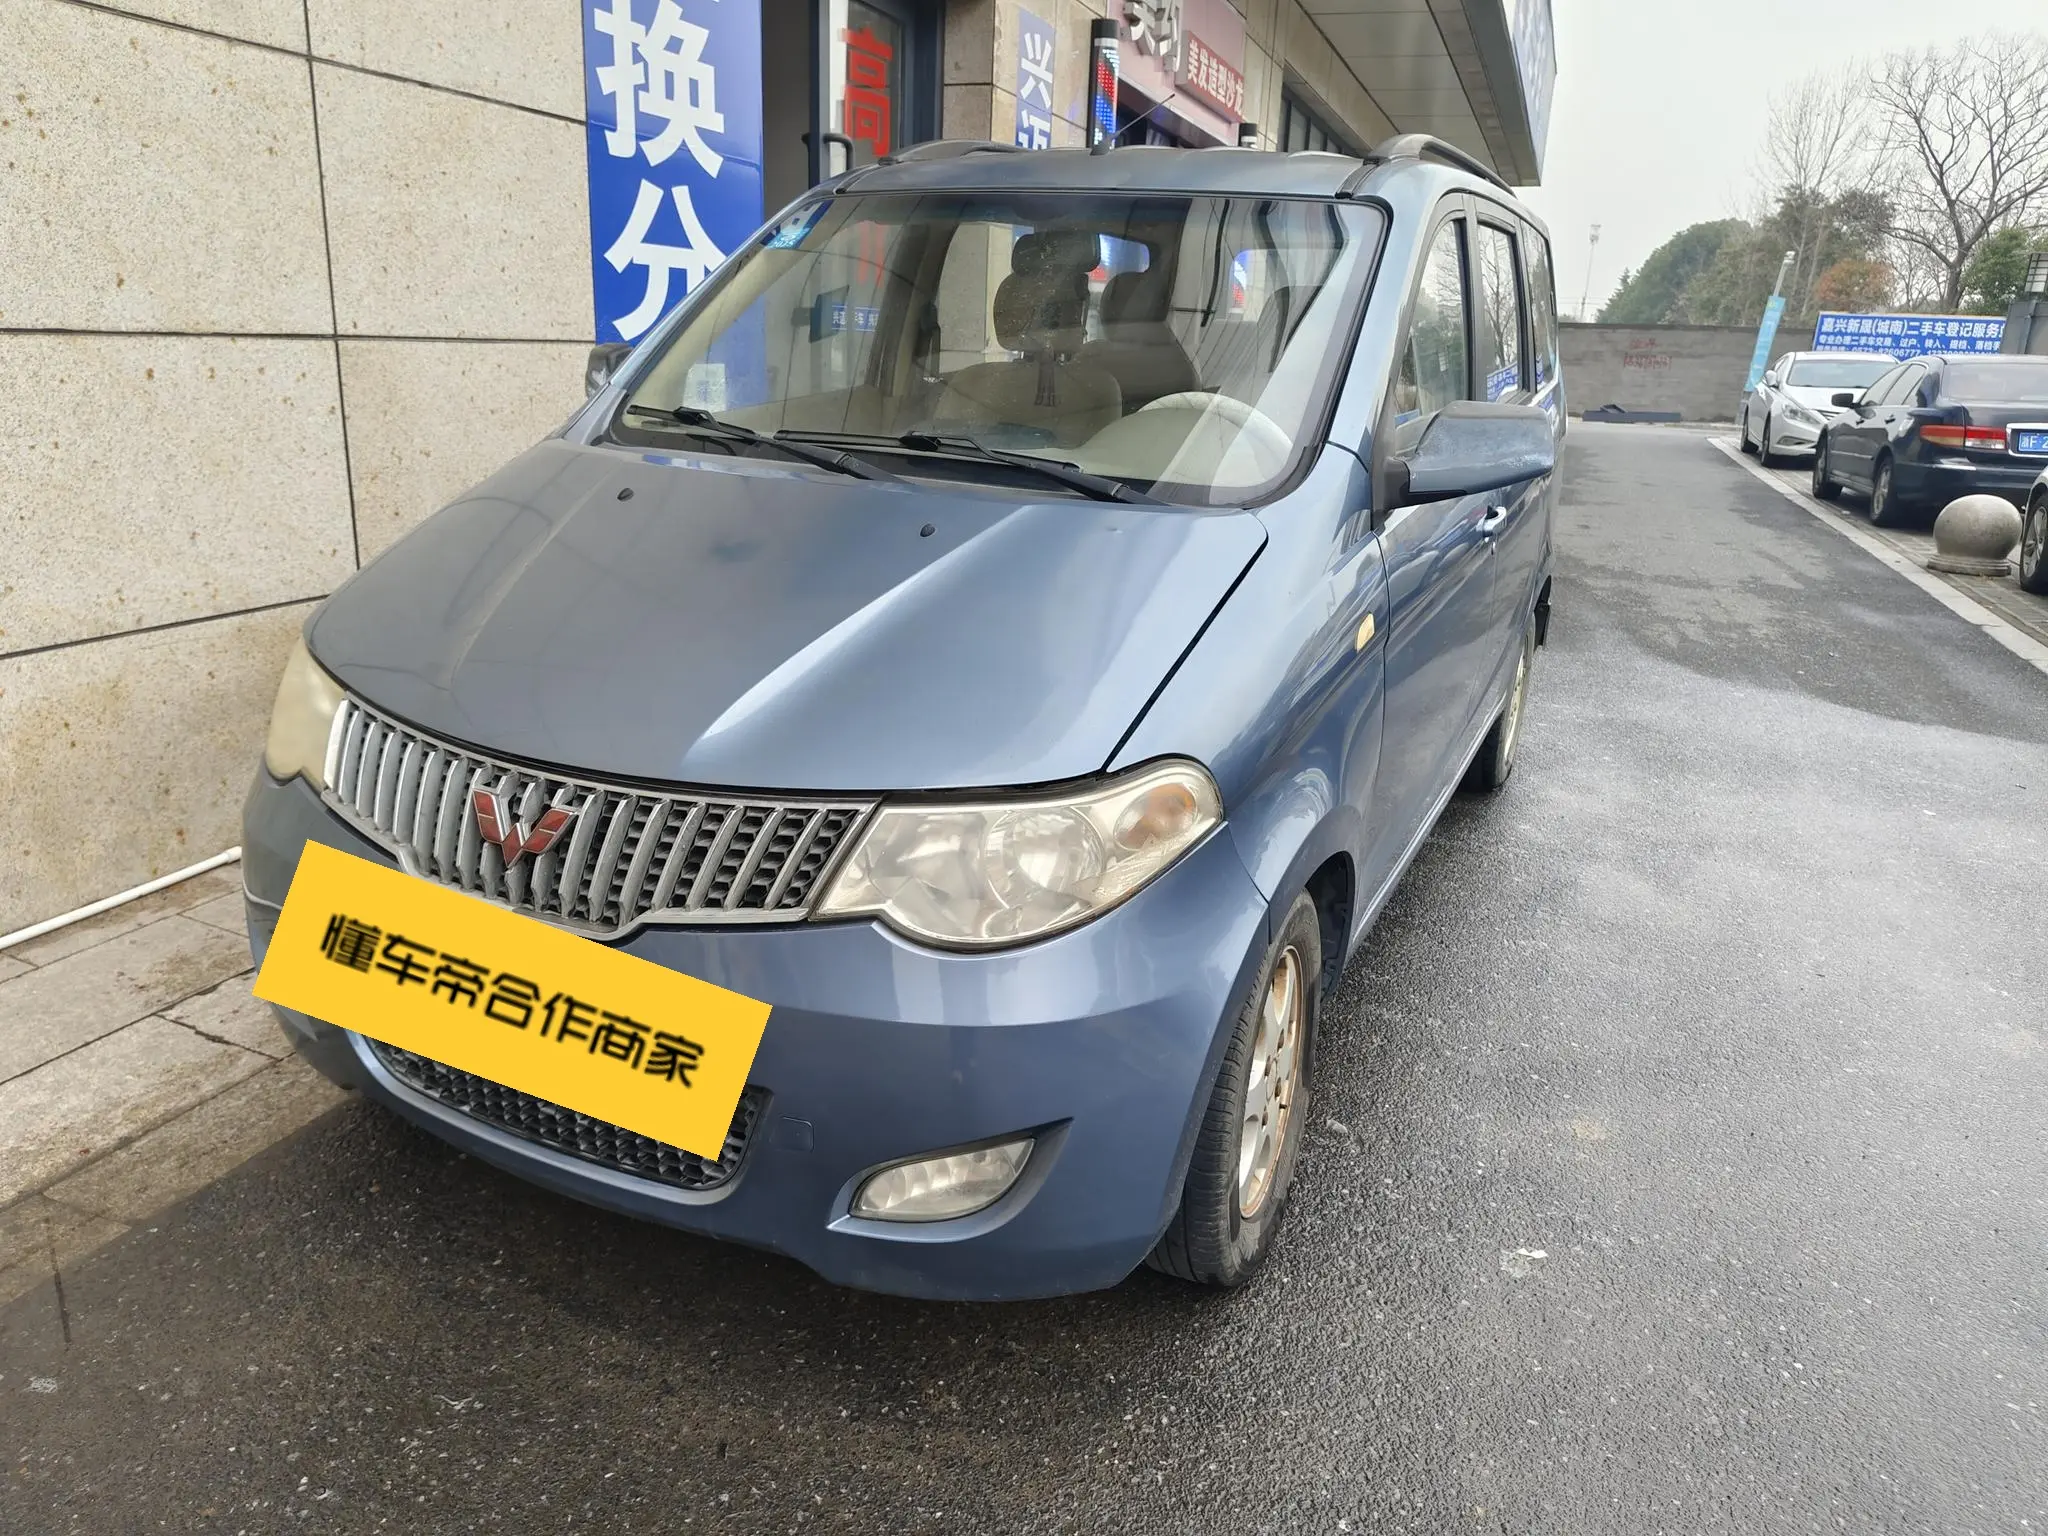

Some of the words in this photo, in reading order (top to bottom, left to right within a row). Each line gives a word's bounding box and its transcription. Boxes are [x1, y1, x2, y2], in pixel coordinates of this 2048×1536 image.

[1187, 39, 1246, 121] 美发造型沙龙
